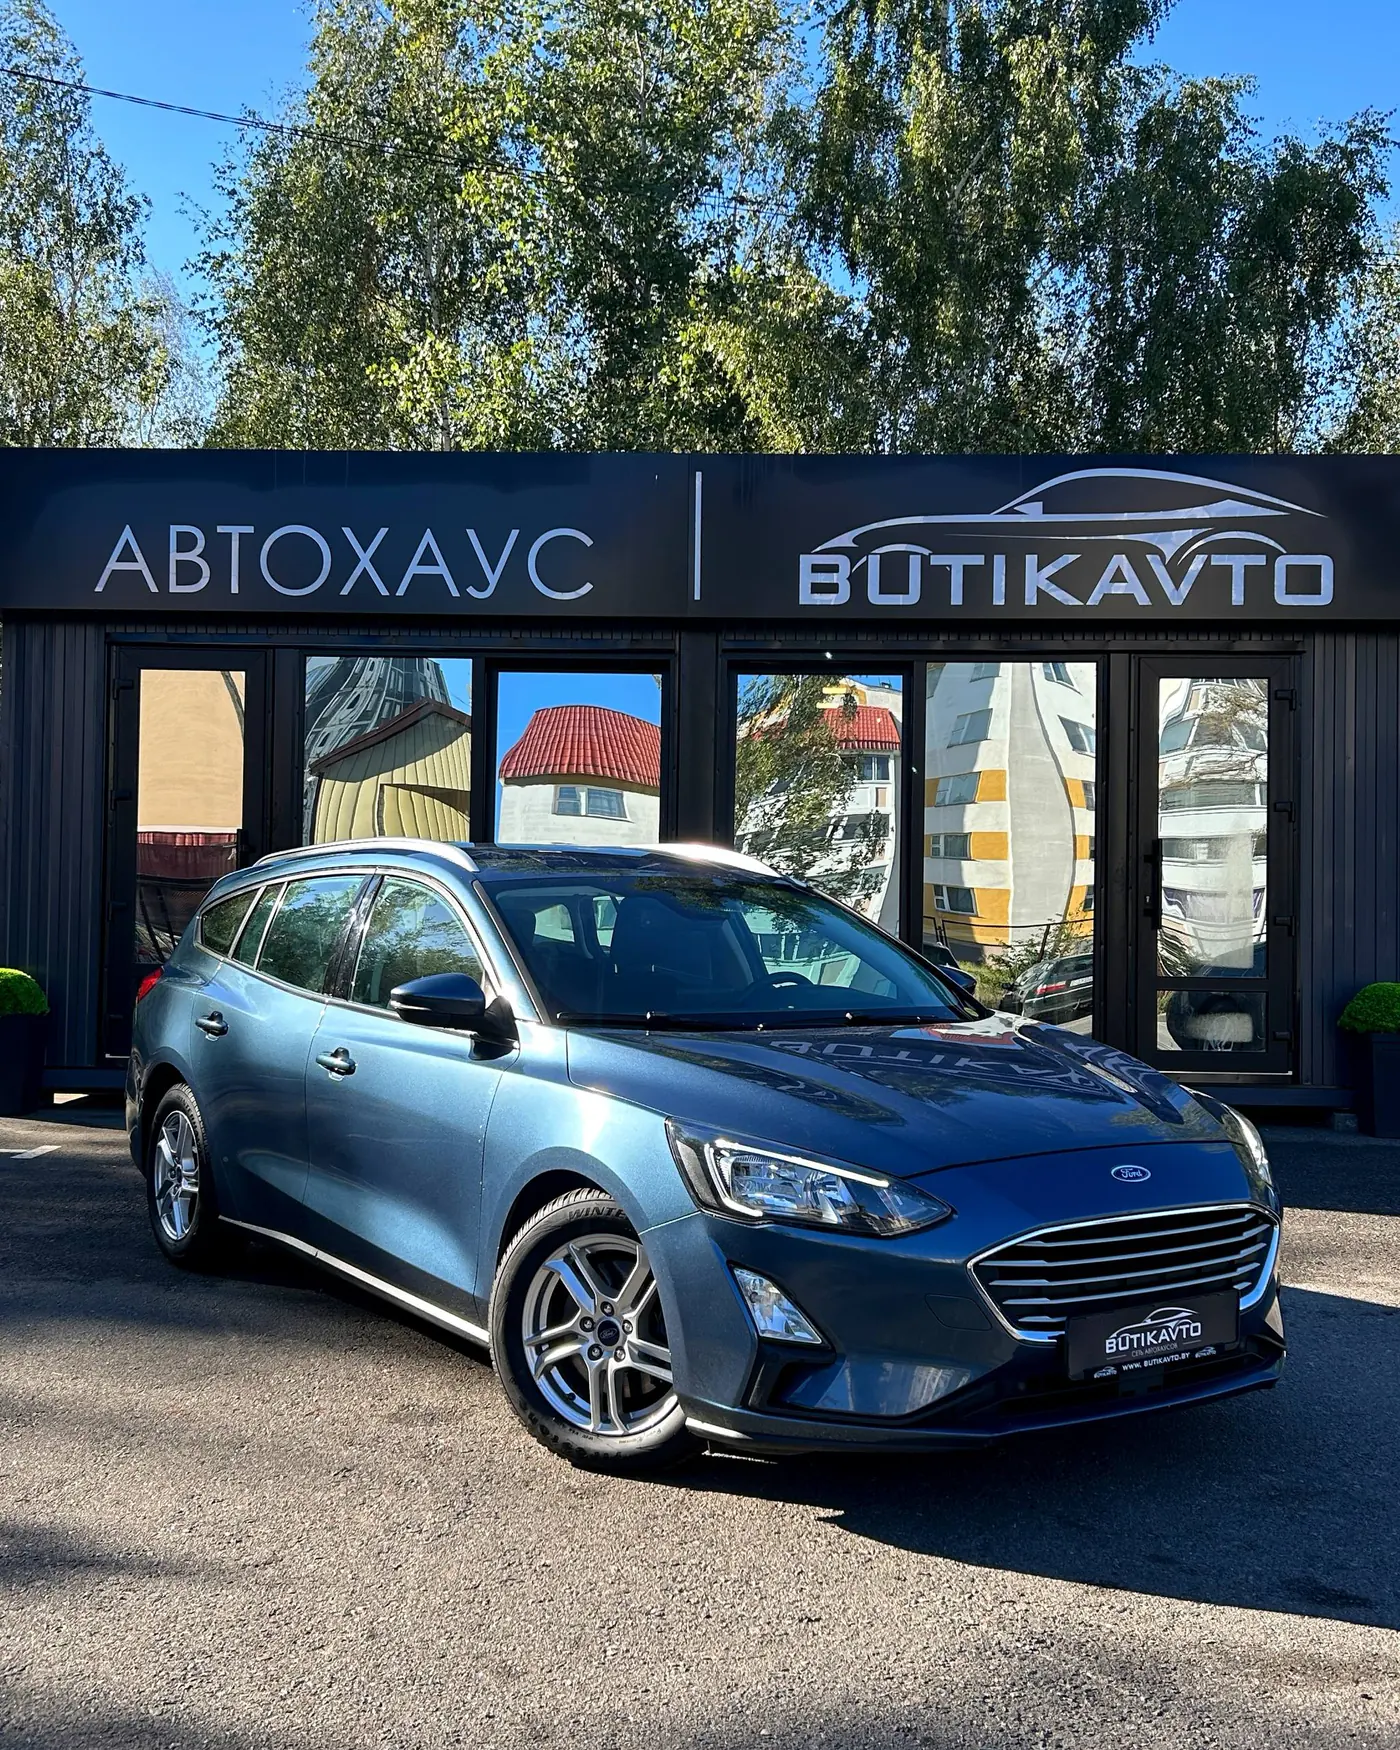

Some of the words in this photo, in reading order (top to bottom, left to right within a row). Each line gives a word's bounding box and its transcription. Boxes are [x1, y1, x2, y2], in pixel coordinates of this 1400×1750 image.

[94, 523, 595, 602] АВТОХАУС
[799, 553, 1335, 606] BUTIKAVTO
[568, 1206, 627, 1220] WINTE
[1105, 1322, 1201, 1353] BUTIKAVTO
